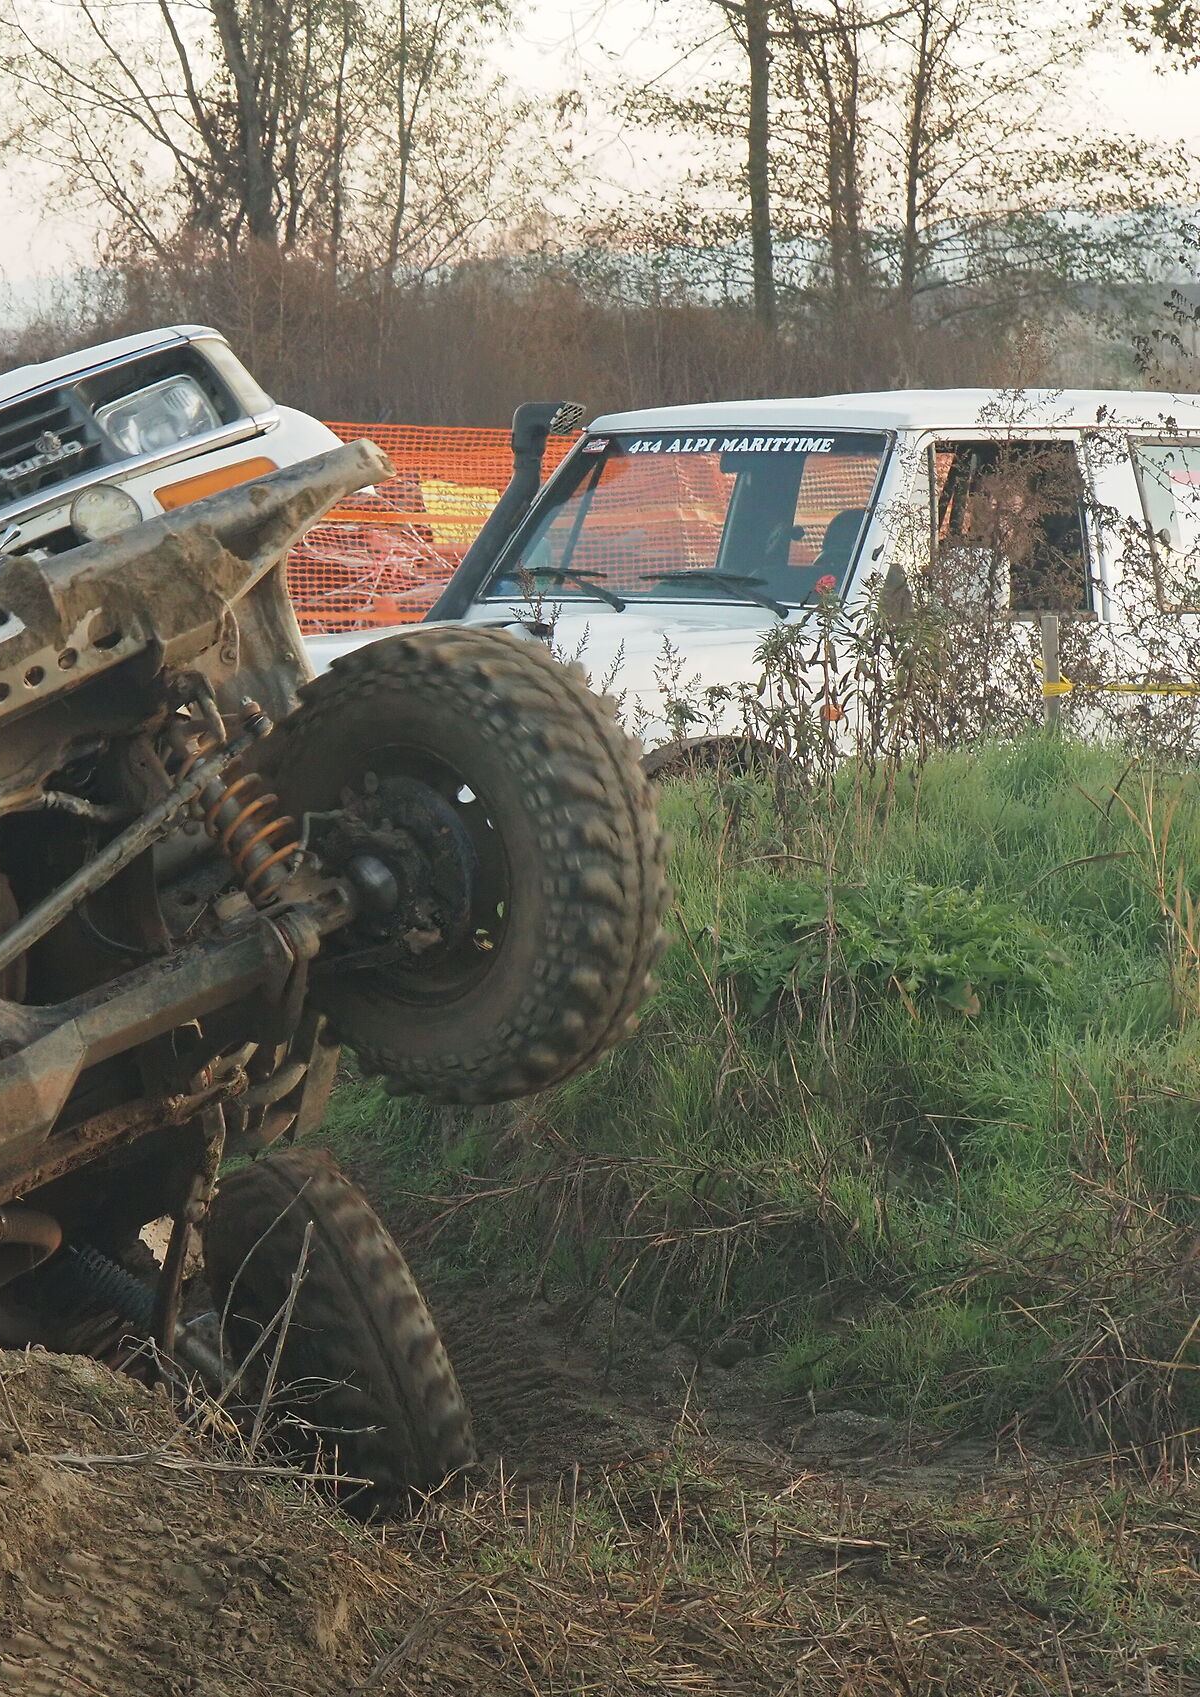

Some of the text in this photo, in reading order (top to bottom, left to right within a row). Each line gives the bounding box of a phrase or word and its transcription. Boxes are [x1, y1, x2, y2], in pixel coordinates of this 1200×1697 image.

[628, 437, 835, 454] 4x4 ALPI MARITTIME
